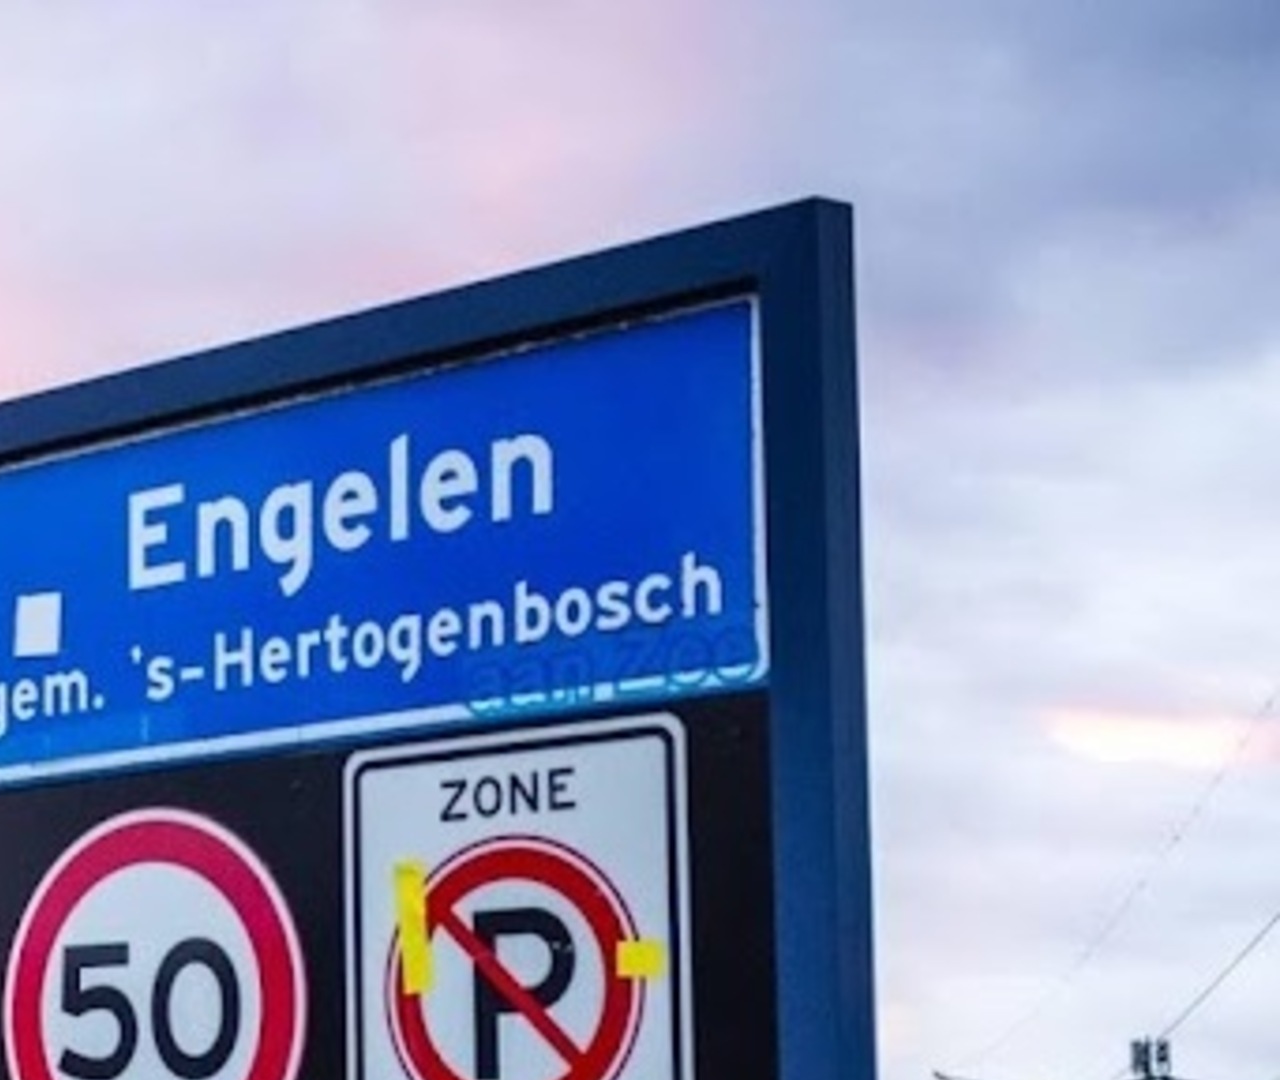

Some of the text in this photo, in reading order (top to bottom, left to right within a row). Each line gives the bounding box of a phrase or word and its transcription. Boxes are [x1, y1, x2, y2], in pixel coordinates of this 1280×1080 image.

[126, 433, 554, 597] Engelen
[130, 551, 723, 702] 's-Hertogenbosch
[440, 765, 578, 822] ZONE
